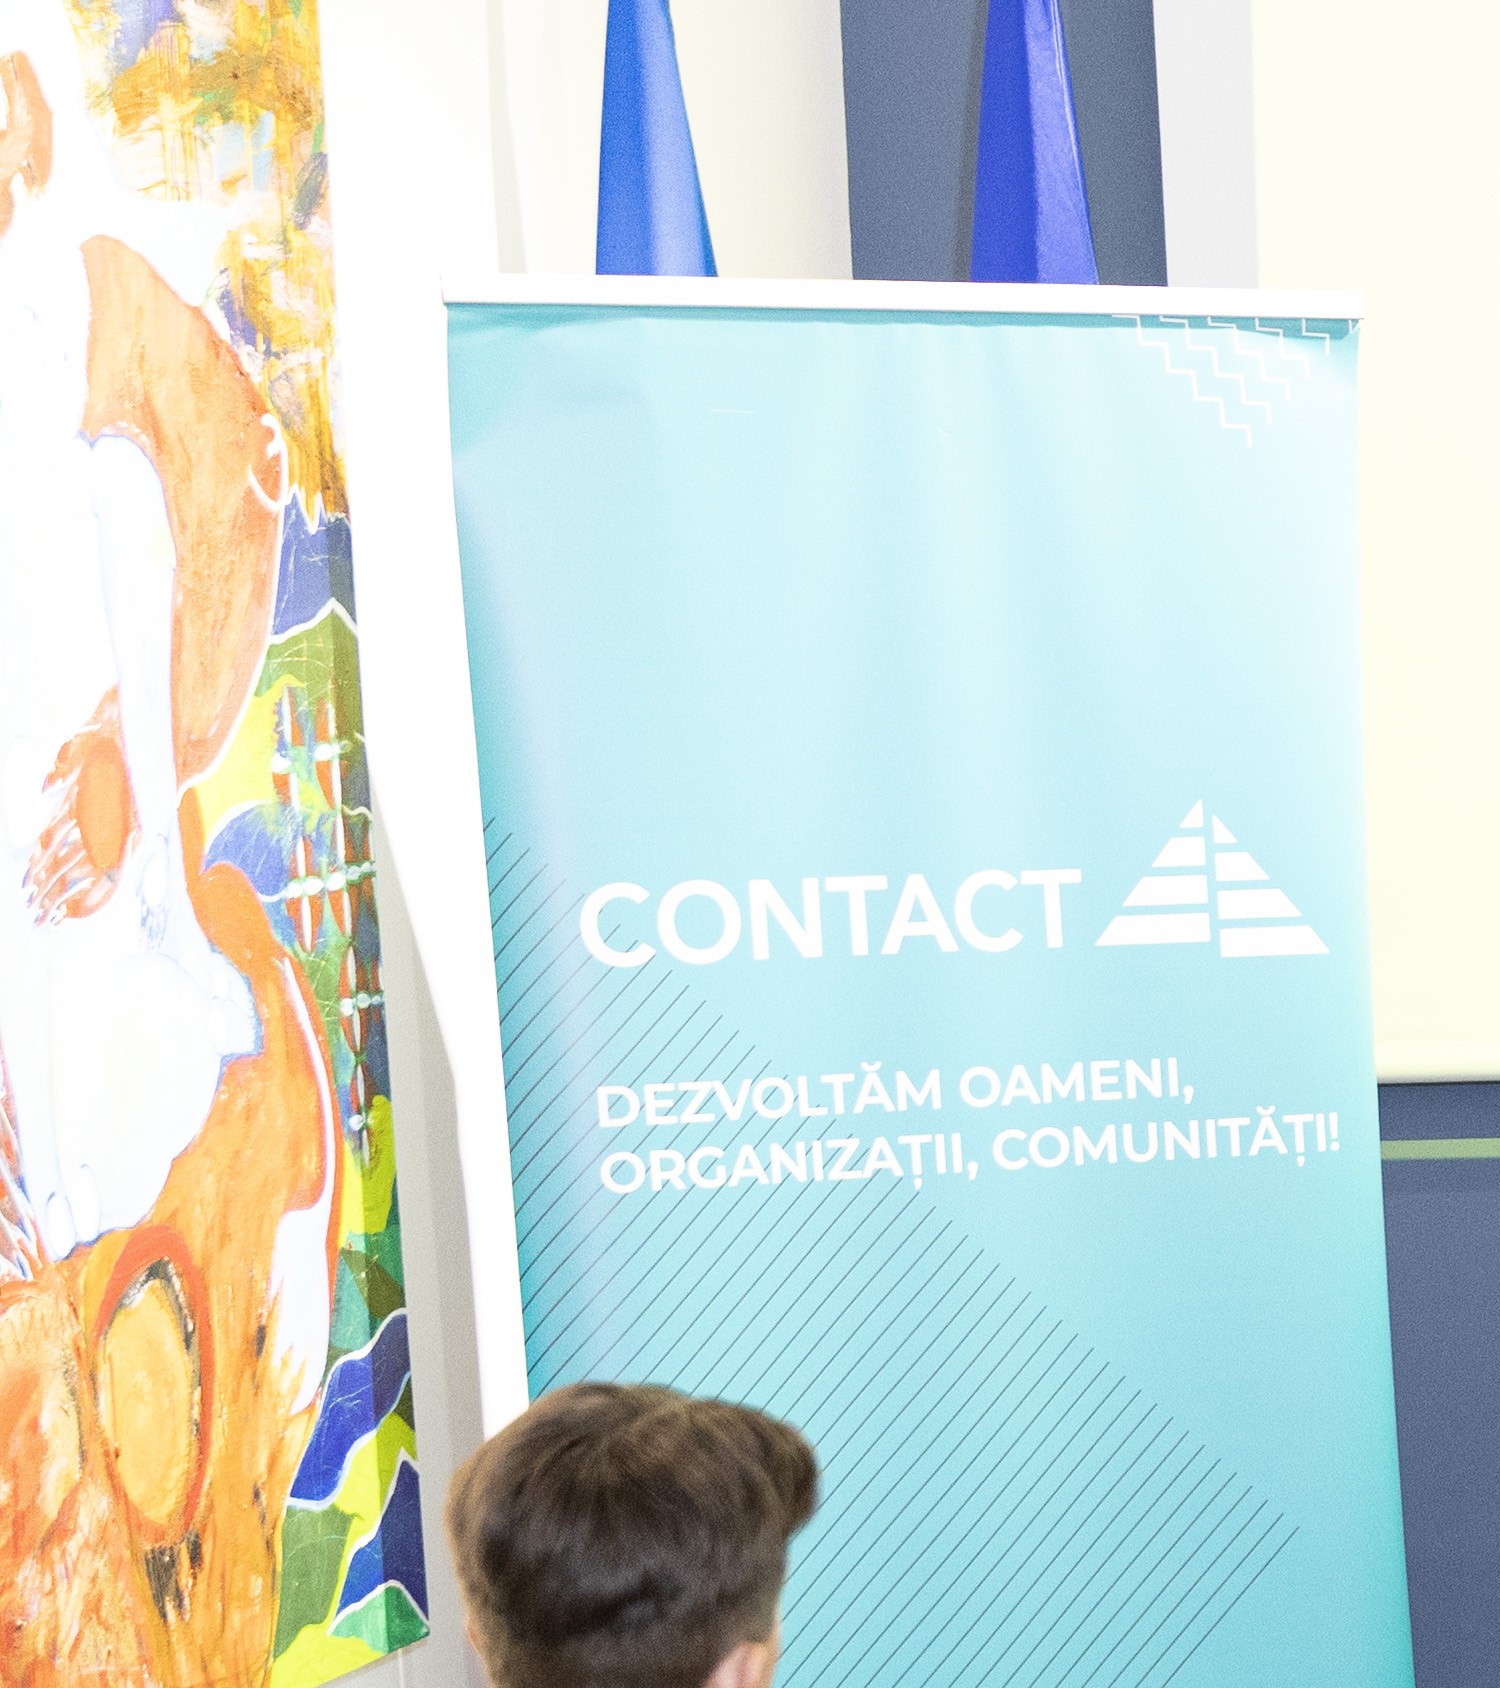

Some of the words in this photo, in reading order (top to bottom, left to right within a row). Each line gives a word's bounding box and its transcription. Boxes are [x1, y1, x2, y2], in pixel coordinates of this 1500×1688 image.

[580, 868, 1081, 968] CONTACT
[598, 1061, 942, 1128] DEZVOLTĂM
[959, 1057, 1195, 1111] OAMENI,
[598, 1131, 978, 1194] ORGANIZAȚII,
[992, 1106, 1341, 1172] COMUNITĂȚI!
